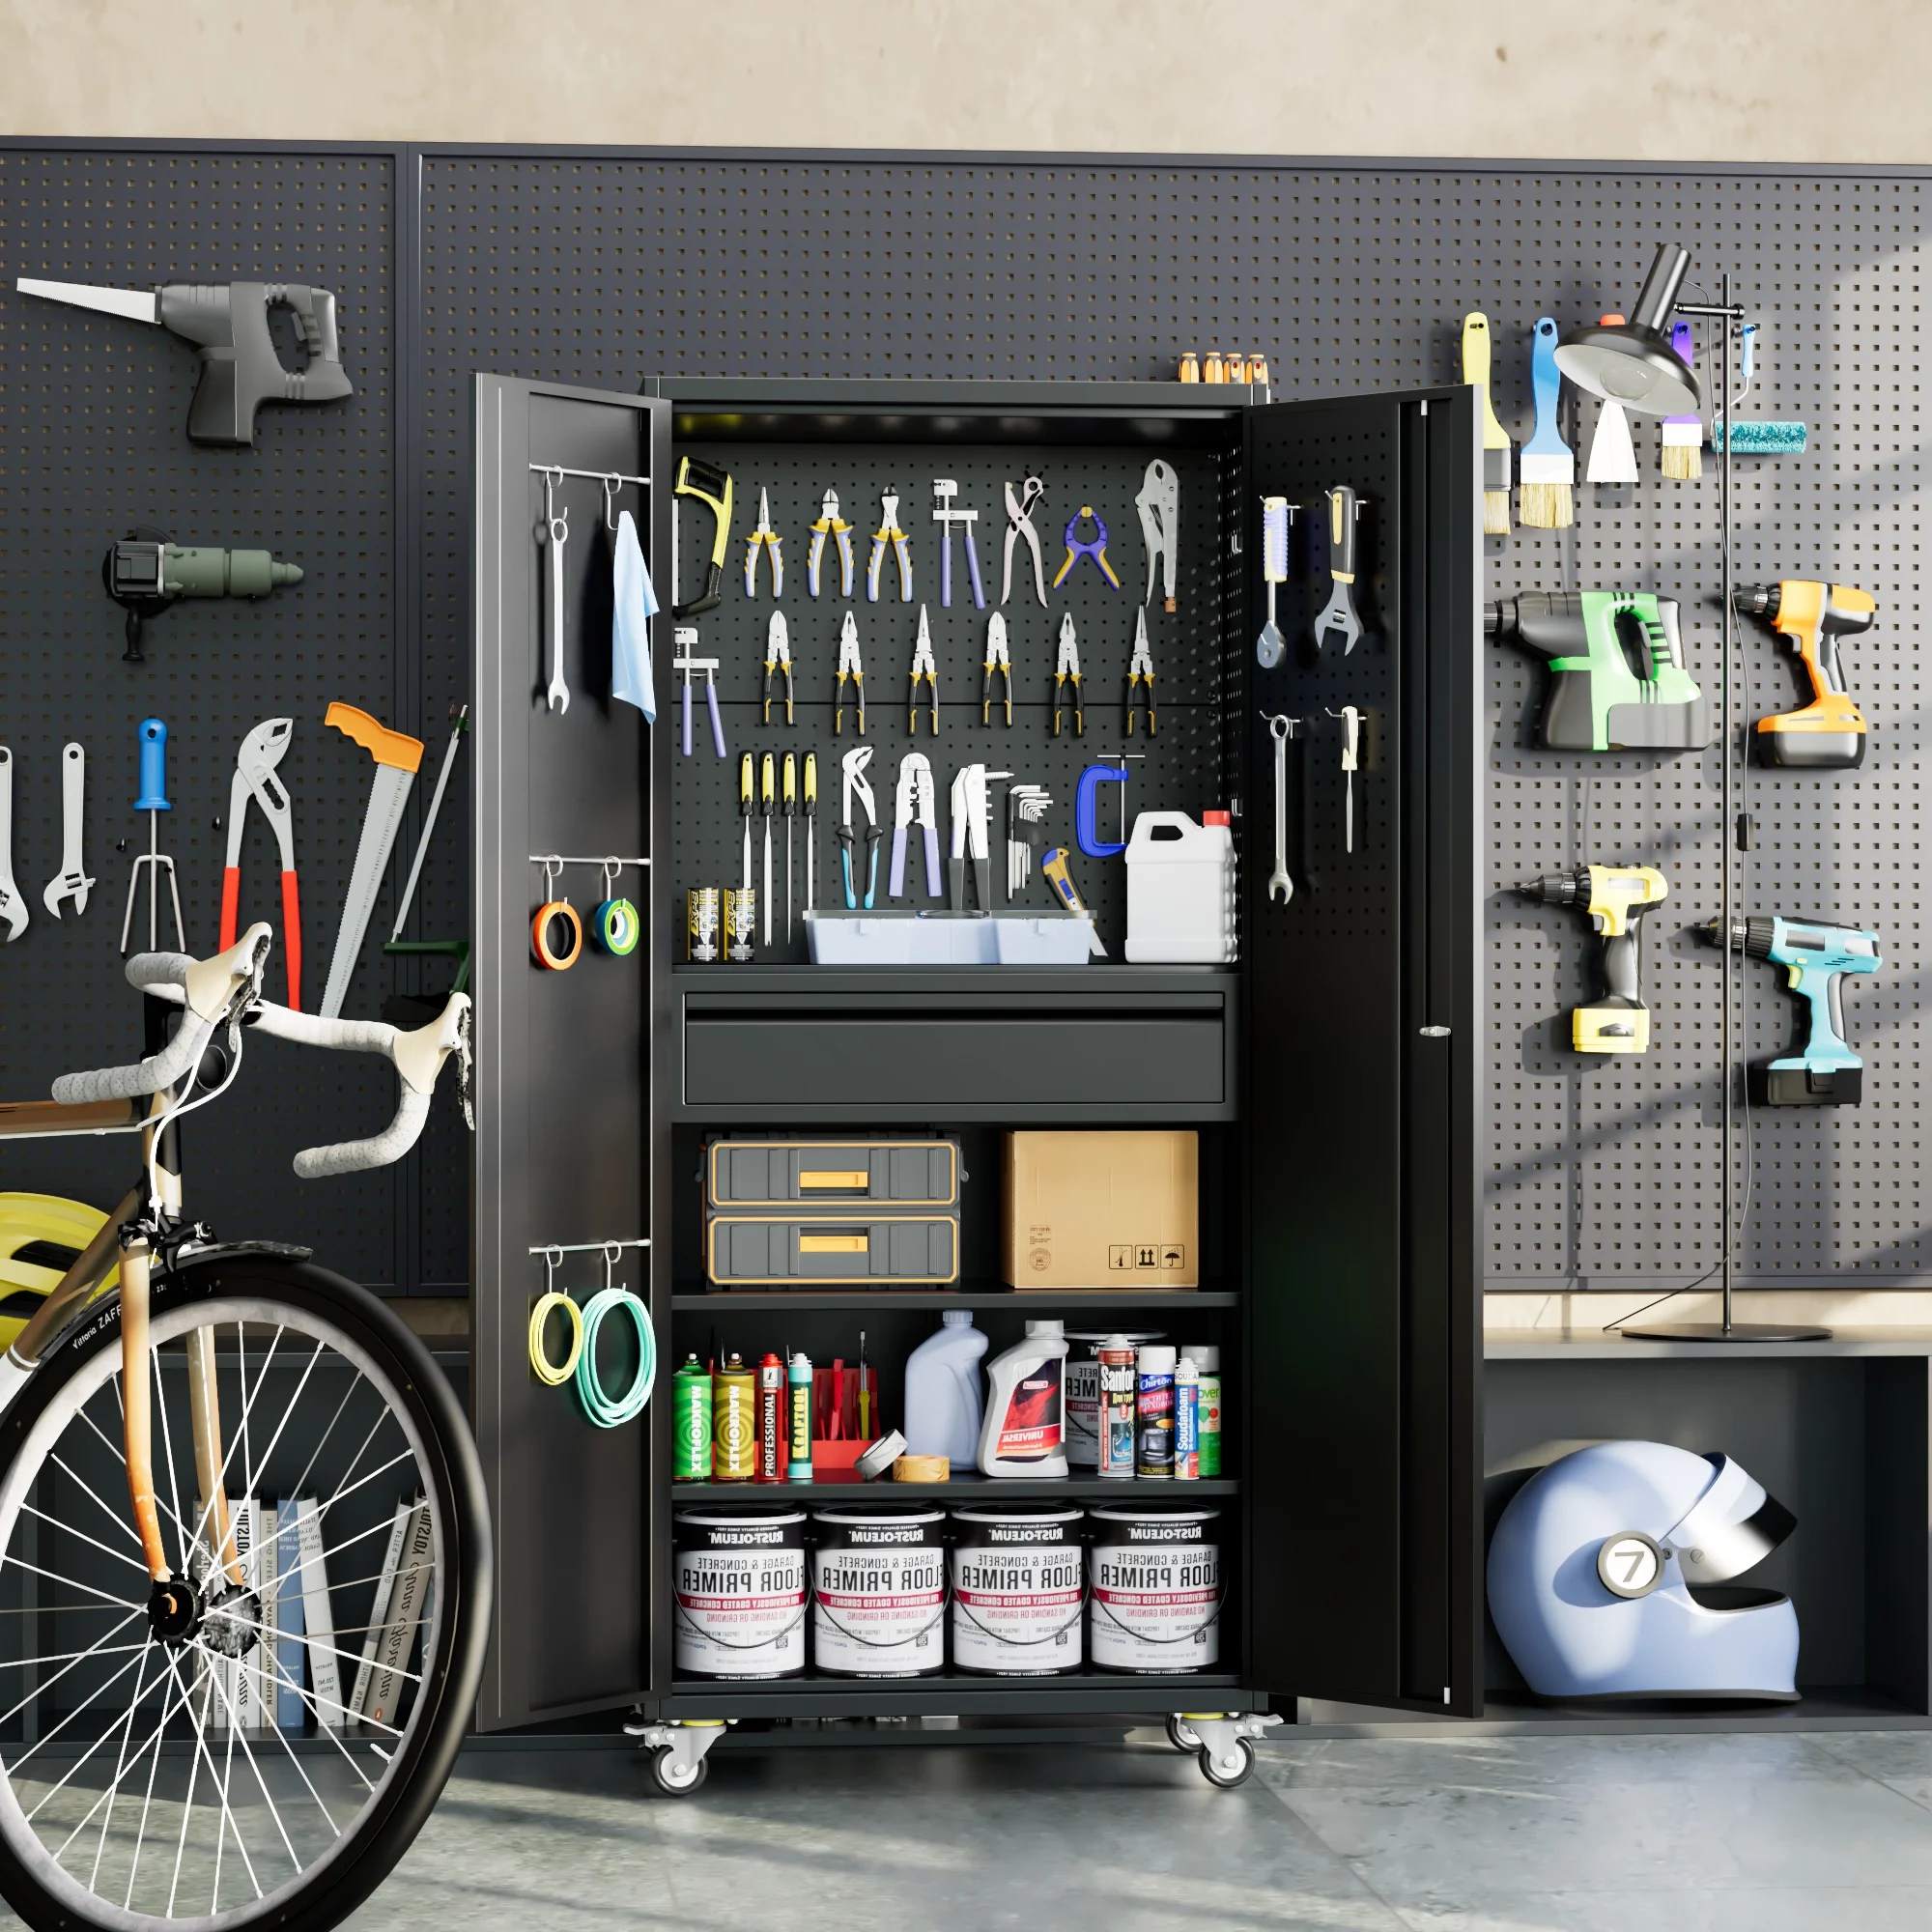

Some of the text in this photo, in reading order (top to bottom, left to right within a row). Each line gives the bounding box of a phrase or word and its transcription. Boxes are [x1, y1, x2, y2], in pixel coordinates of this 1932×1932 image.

[73, 1304, 121, 1349] Vittoria ZAFF
[1101, 1365, 1135, 1392] Sanfor
[1198, 1388, 1219, 1398] over
[691, 1385, 702, 1472] MAKROFLEX
[729, 1385, 740, 1472] MAKROFLEX
[765, 1392, 775, 1477] PROFESSIONAL
[792, 1387, 808, 1458] KRAFTOOL
[1177, 1388, 1188, 1450] Soudafoam
[1615, 1551, 1645, 1582] 7
